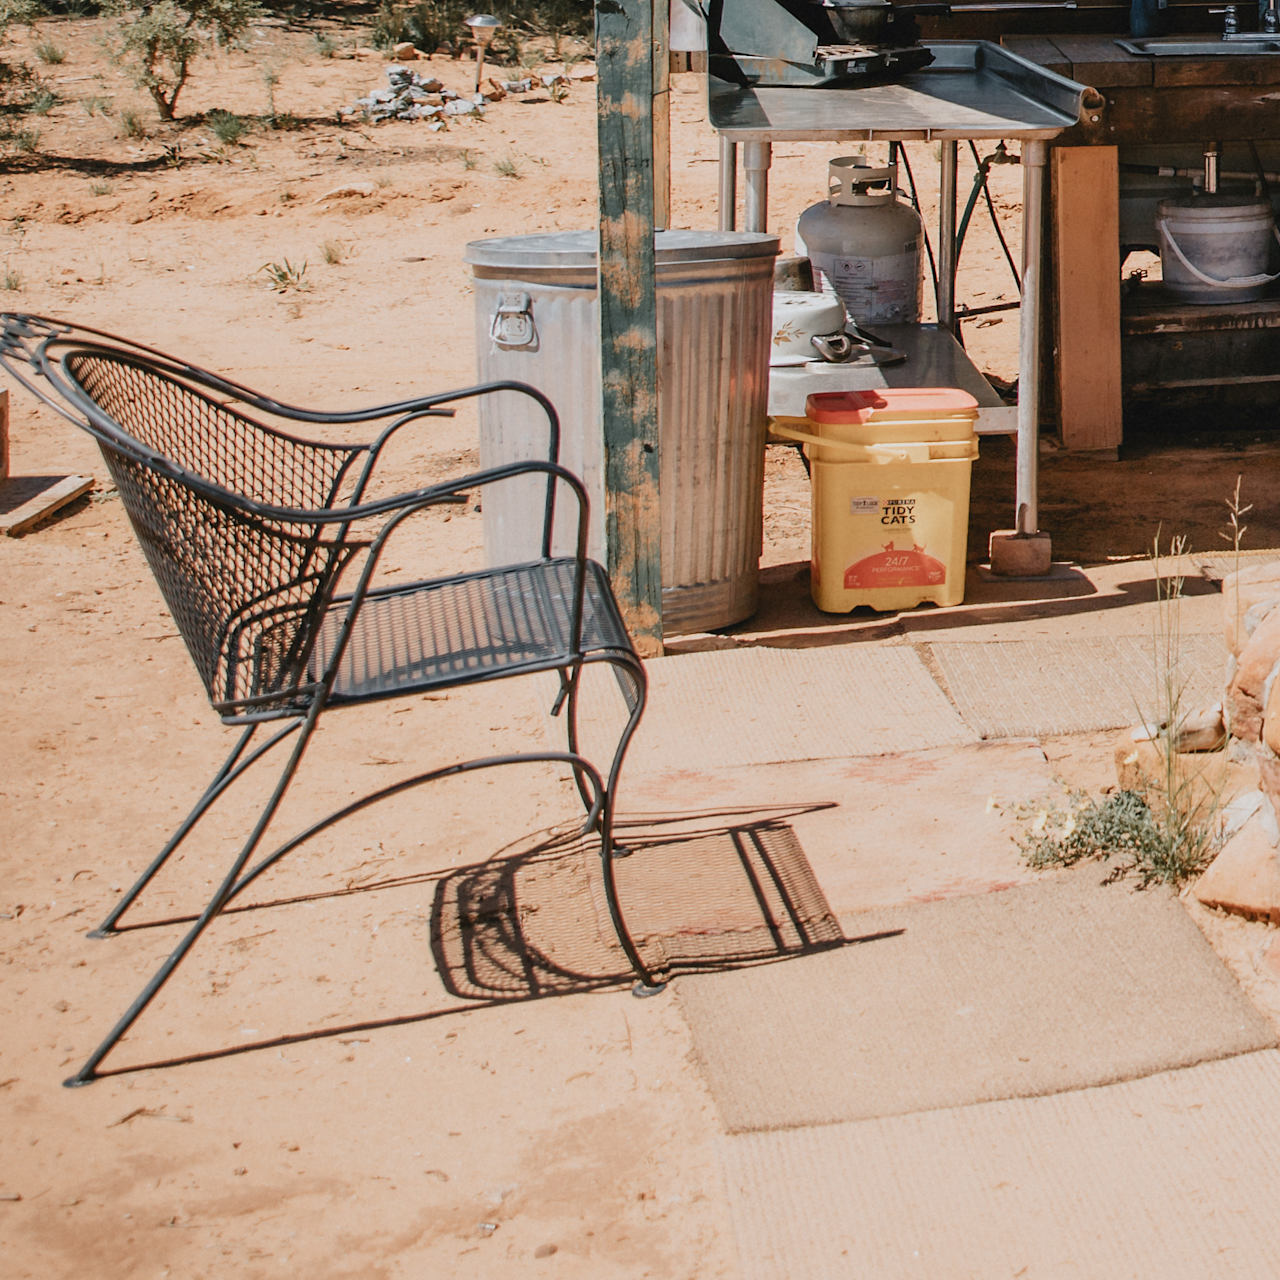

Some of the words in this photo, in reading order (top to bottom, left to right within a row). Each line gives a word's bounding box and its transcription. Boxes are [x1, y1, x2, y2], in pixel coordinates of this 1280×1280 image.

[882, 506, 914, 516] TIDY
[881, 515, 916, 525] CATS
[886, 556, 910, 567] 24/7
